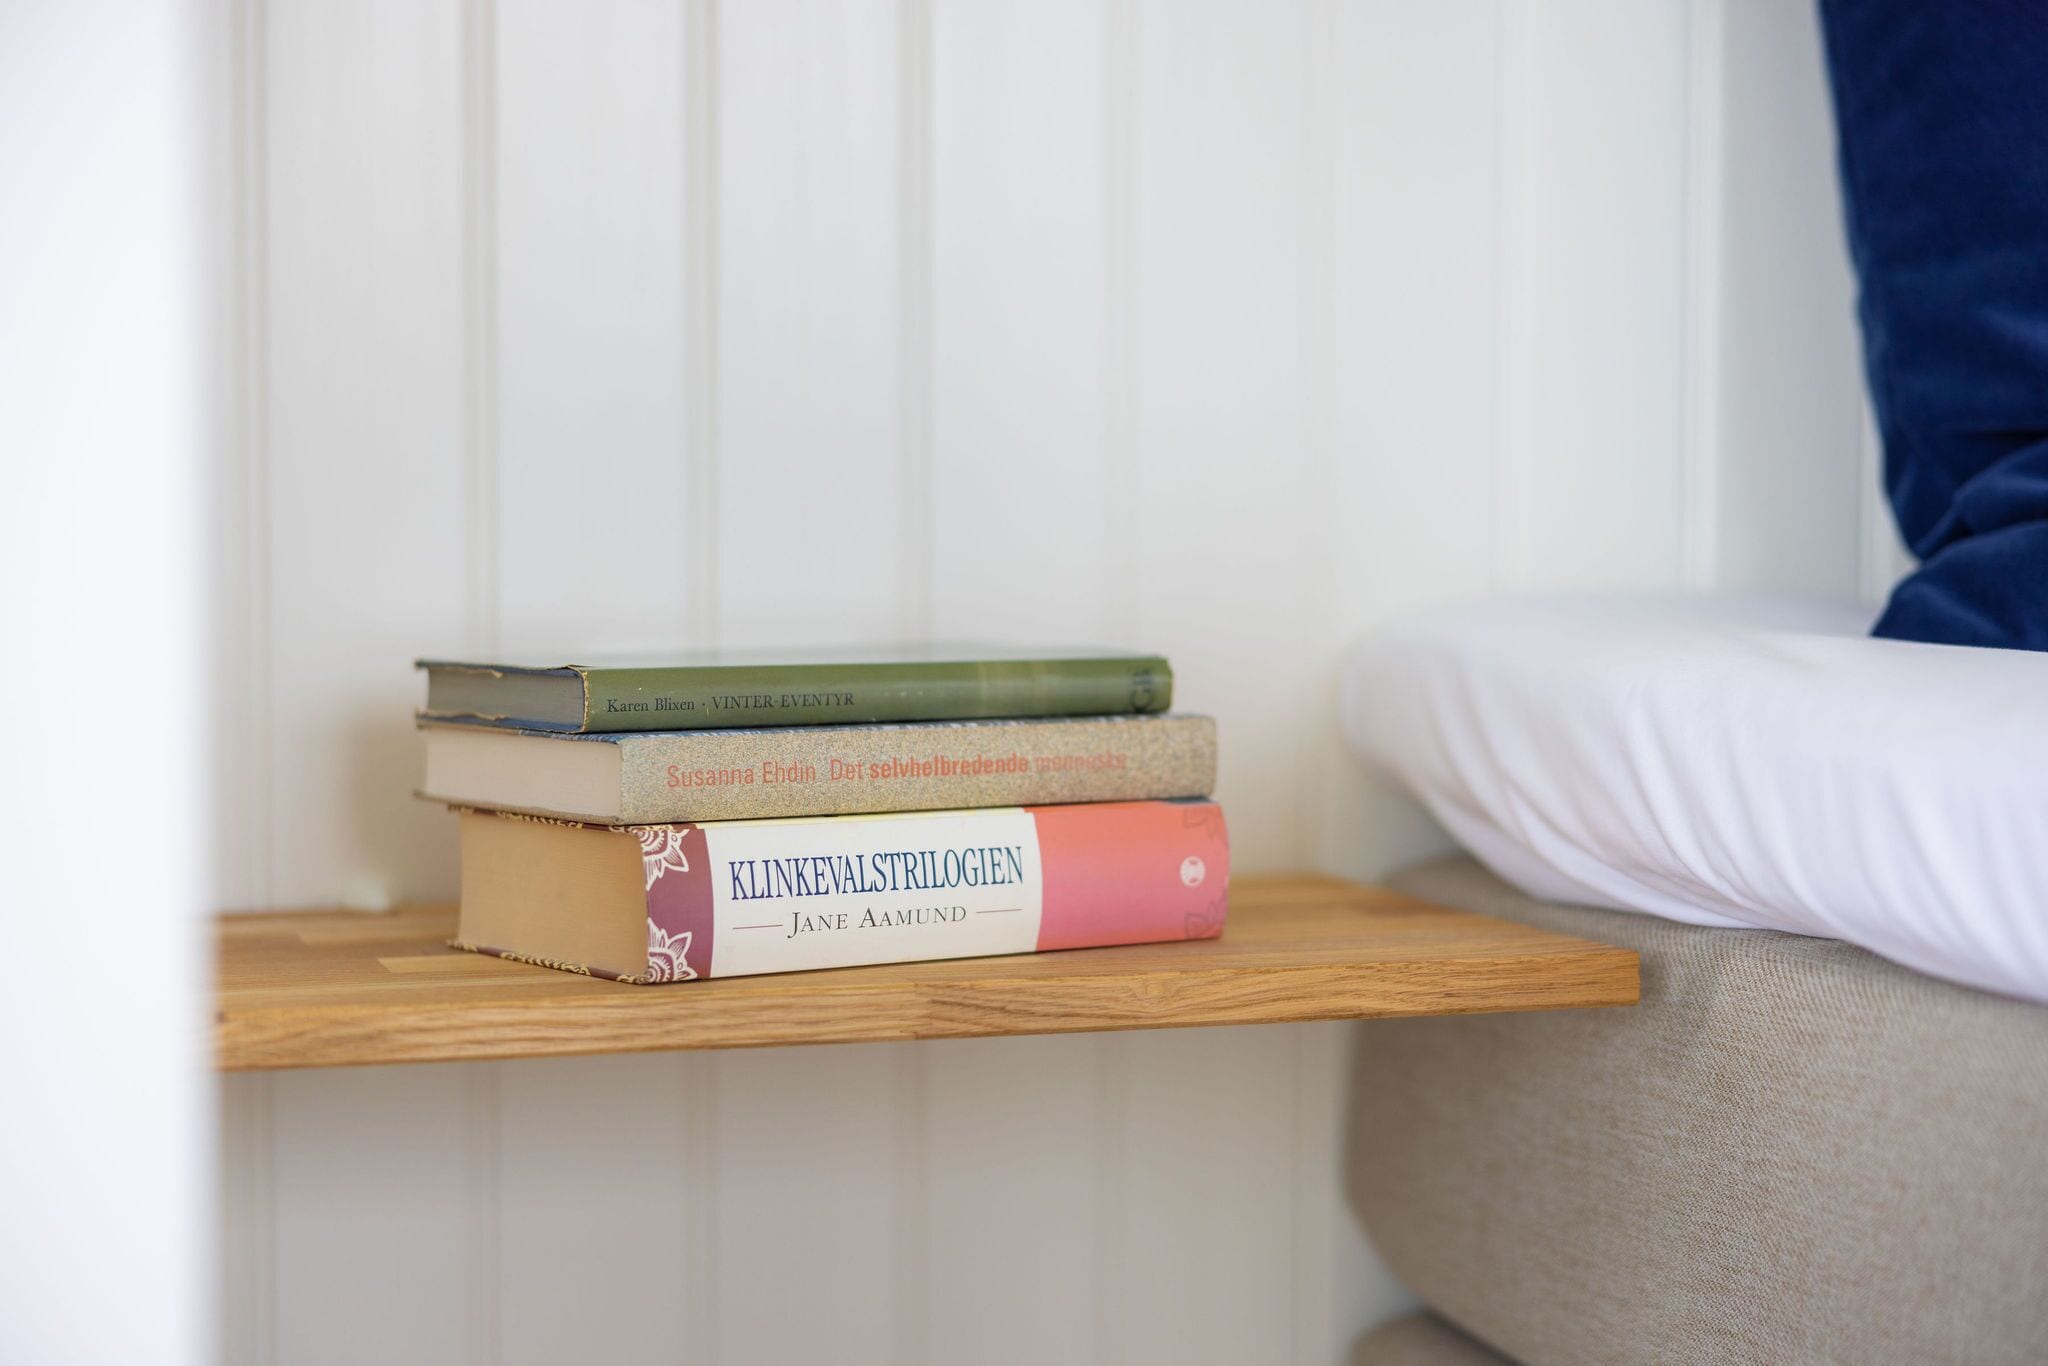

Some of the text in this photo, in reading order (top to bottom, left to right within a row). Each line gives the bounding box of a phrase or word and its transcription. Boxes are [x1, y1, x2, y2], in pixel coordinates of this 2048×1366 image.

[607, 692, 855, 713] Karen Blixen VINTER-EVENTYR
[667, 750, 1127, 788] Susanna Ehdin Det selvhelbredende menneske
[728, 846, 1024, 900] KLINKEVALSTRILOGIEN
[787, 906, 967, 938] JANE AAMUND
